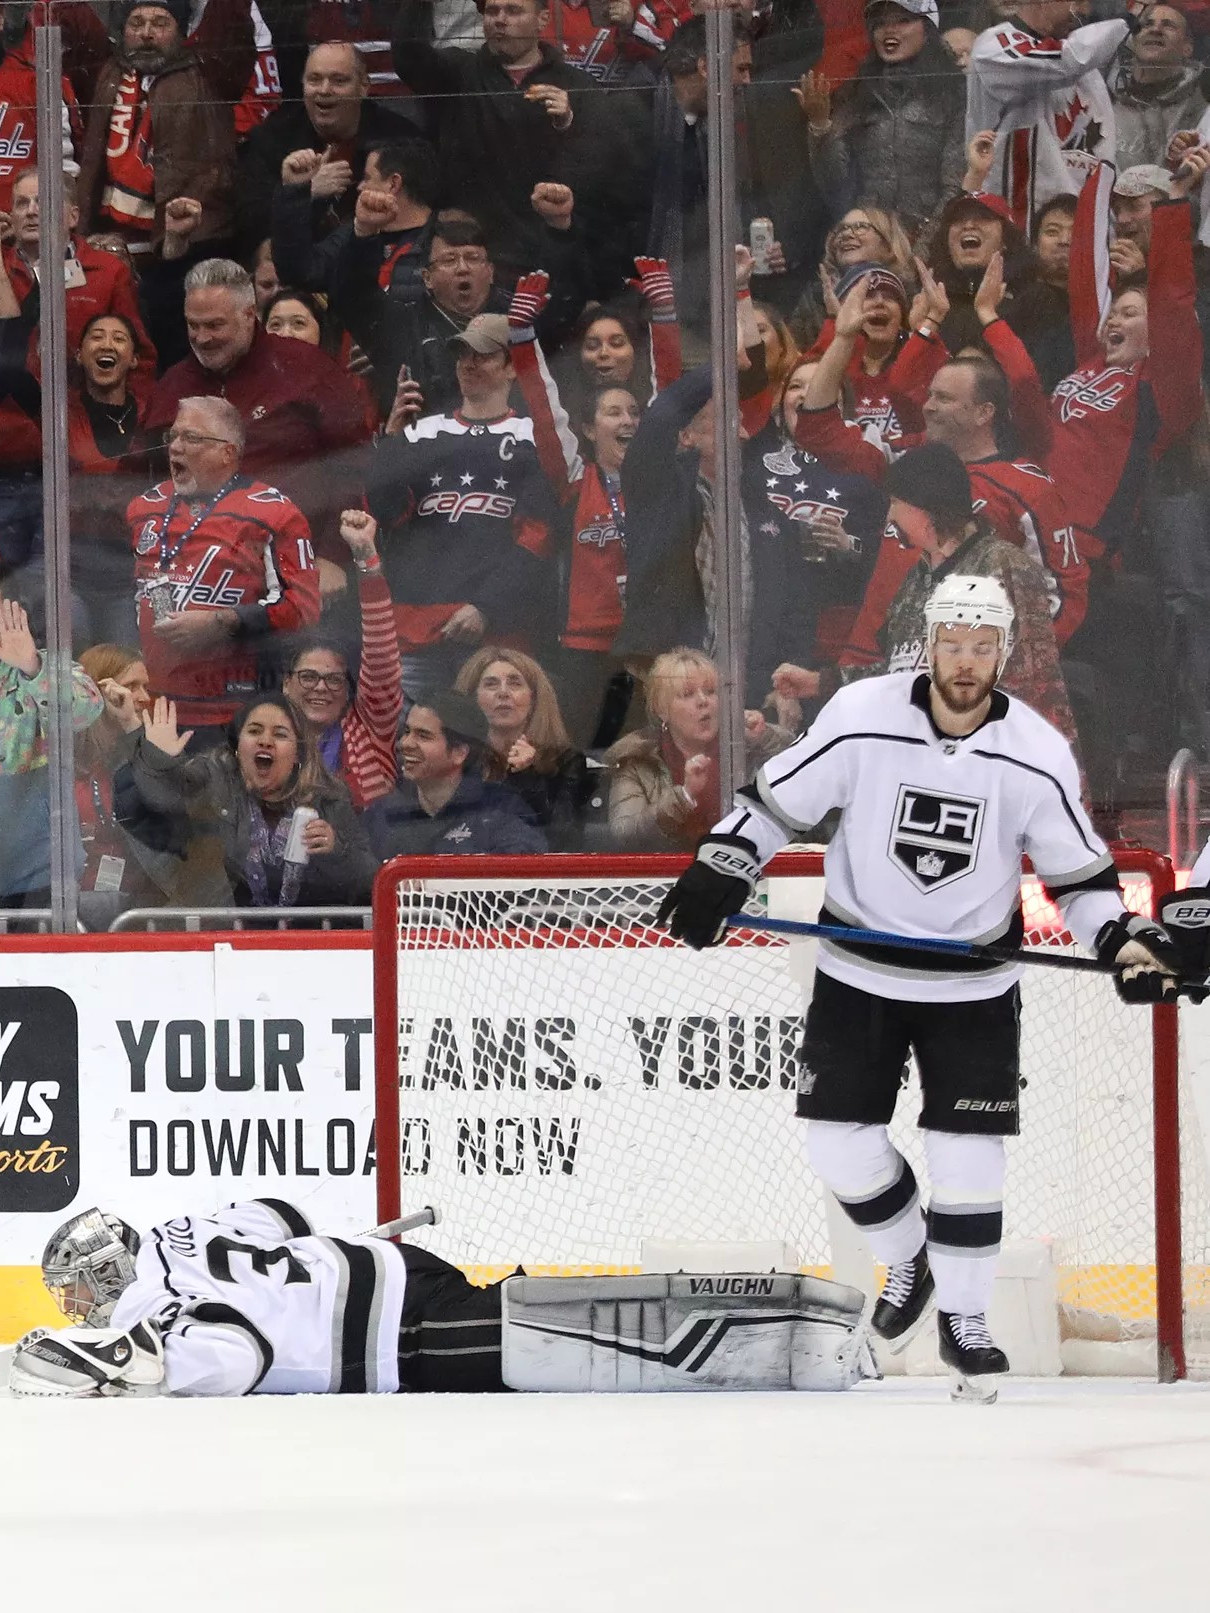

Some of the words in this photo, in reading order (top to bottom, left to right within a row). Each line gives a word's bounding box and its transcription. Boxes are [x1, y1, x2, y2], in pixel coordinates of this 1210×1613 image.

[254, 55, 283, 95] 19
[498, 434, 517, 461] C
[418, 491, 517, 523] caps
[899, 790, 980, 841] LA
[115, 1018, 306, 1093] YOUR
[457, 1117, 583, 1176] NOW
[689, 1277, 775, 1297] VAUGHN
